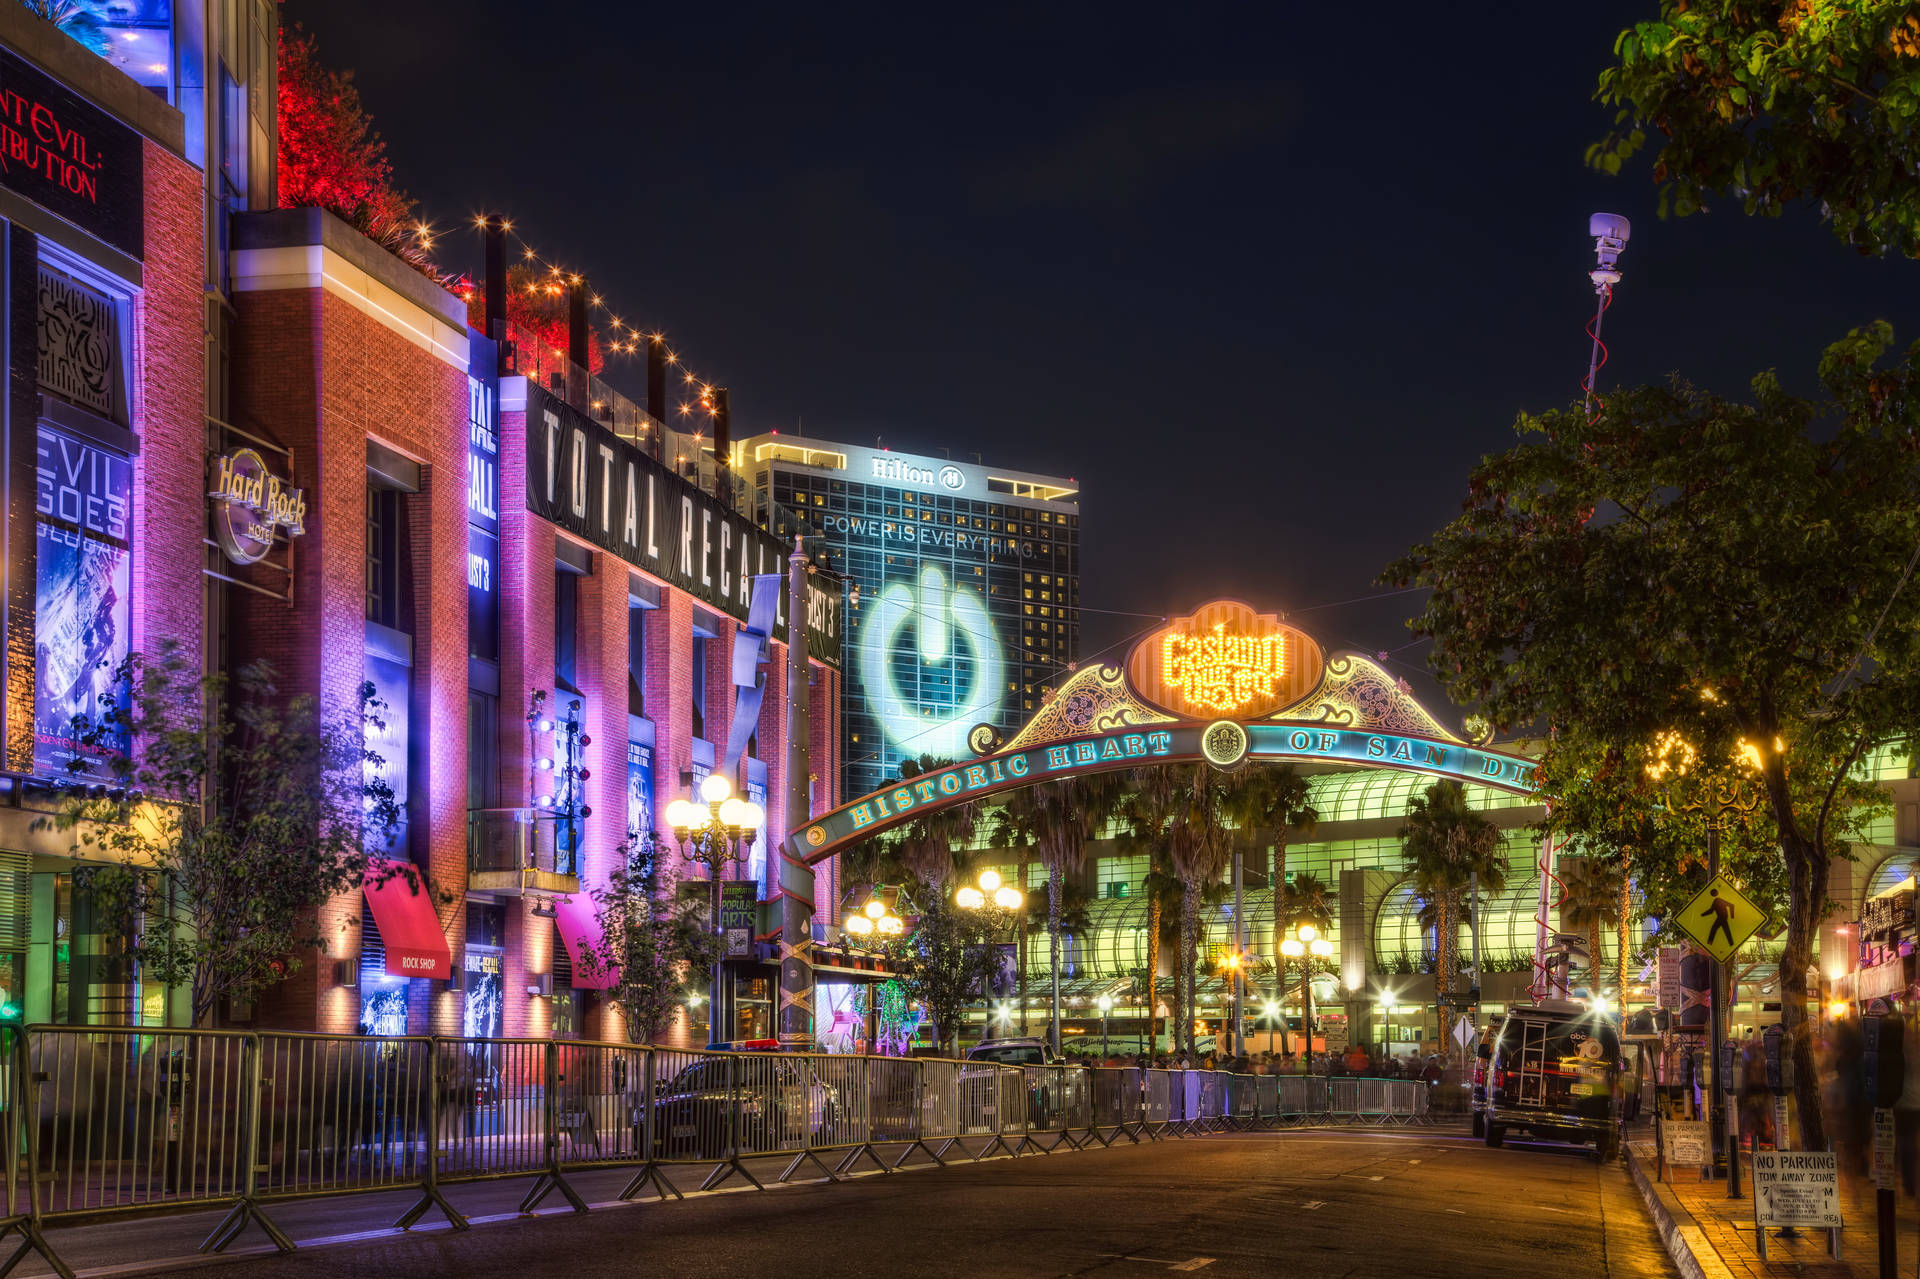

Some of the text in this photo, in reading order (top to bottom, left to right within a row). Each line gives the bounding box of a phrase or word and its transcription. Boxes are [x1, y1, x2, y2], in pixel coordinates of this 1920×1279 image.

[30, 101, 102, 171] EVIL:
[0, 122, 96, 204] IBUTION
[37, 429, 126, 505] EVIL
[543, 409, 659, 559] TOTAL
[871, 456, 935, 486] Hilton
[219, 456, 306, 535] Hard Rock
[247, 520, 274, 545] HOTEL
[823, 515, 1039, 560] POWER IS EVERYTHING.
[483, 558, 490, 592] 3
[828, 596, 834, 638] 3
[849, 753, 1029, 829] HISTORIC
[1048, 732, 1170, 769] HEART
[1290, 731, 1337, 752] OF
[1368, 736, 1449, 766] SAN
[721, 911, 757, 928] ARTS
[402, 957, 436, 970] ROCK SHOP
[1570, 1032, 1587, 1041] abc
[1757, 1155, 1835, 1170] NO PARKING
[1758, 1172, 1836, 1183] TOW AWAY ZONE
